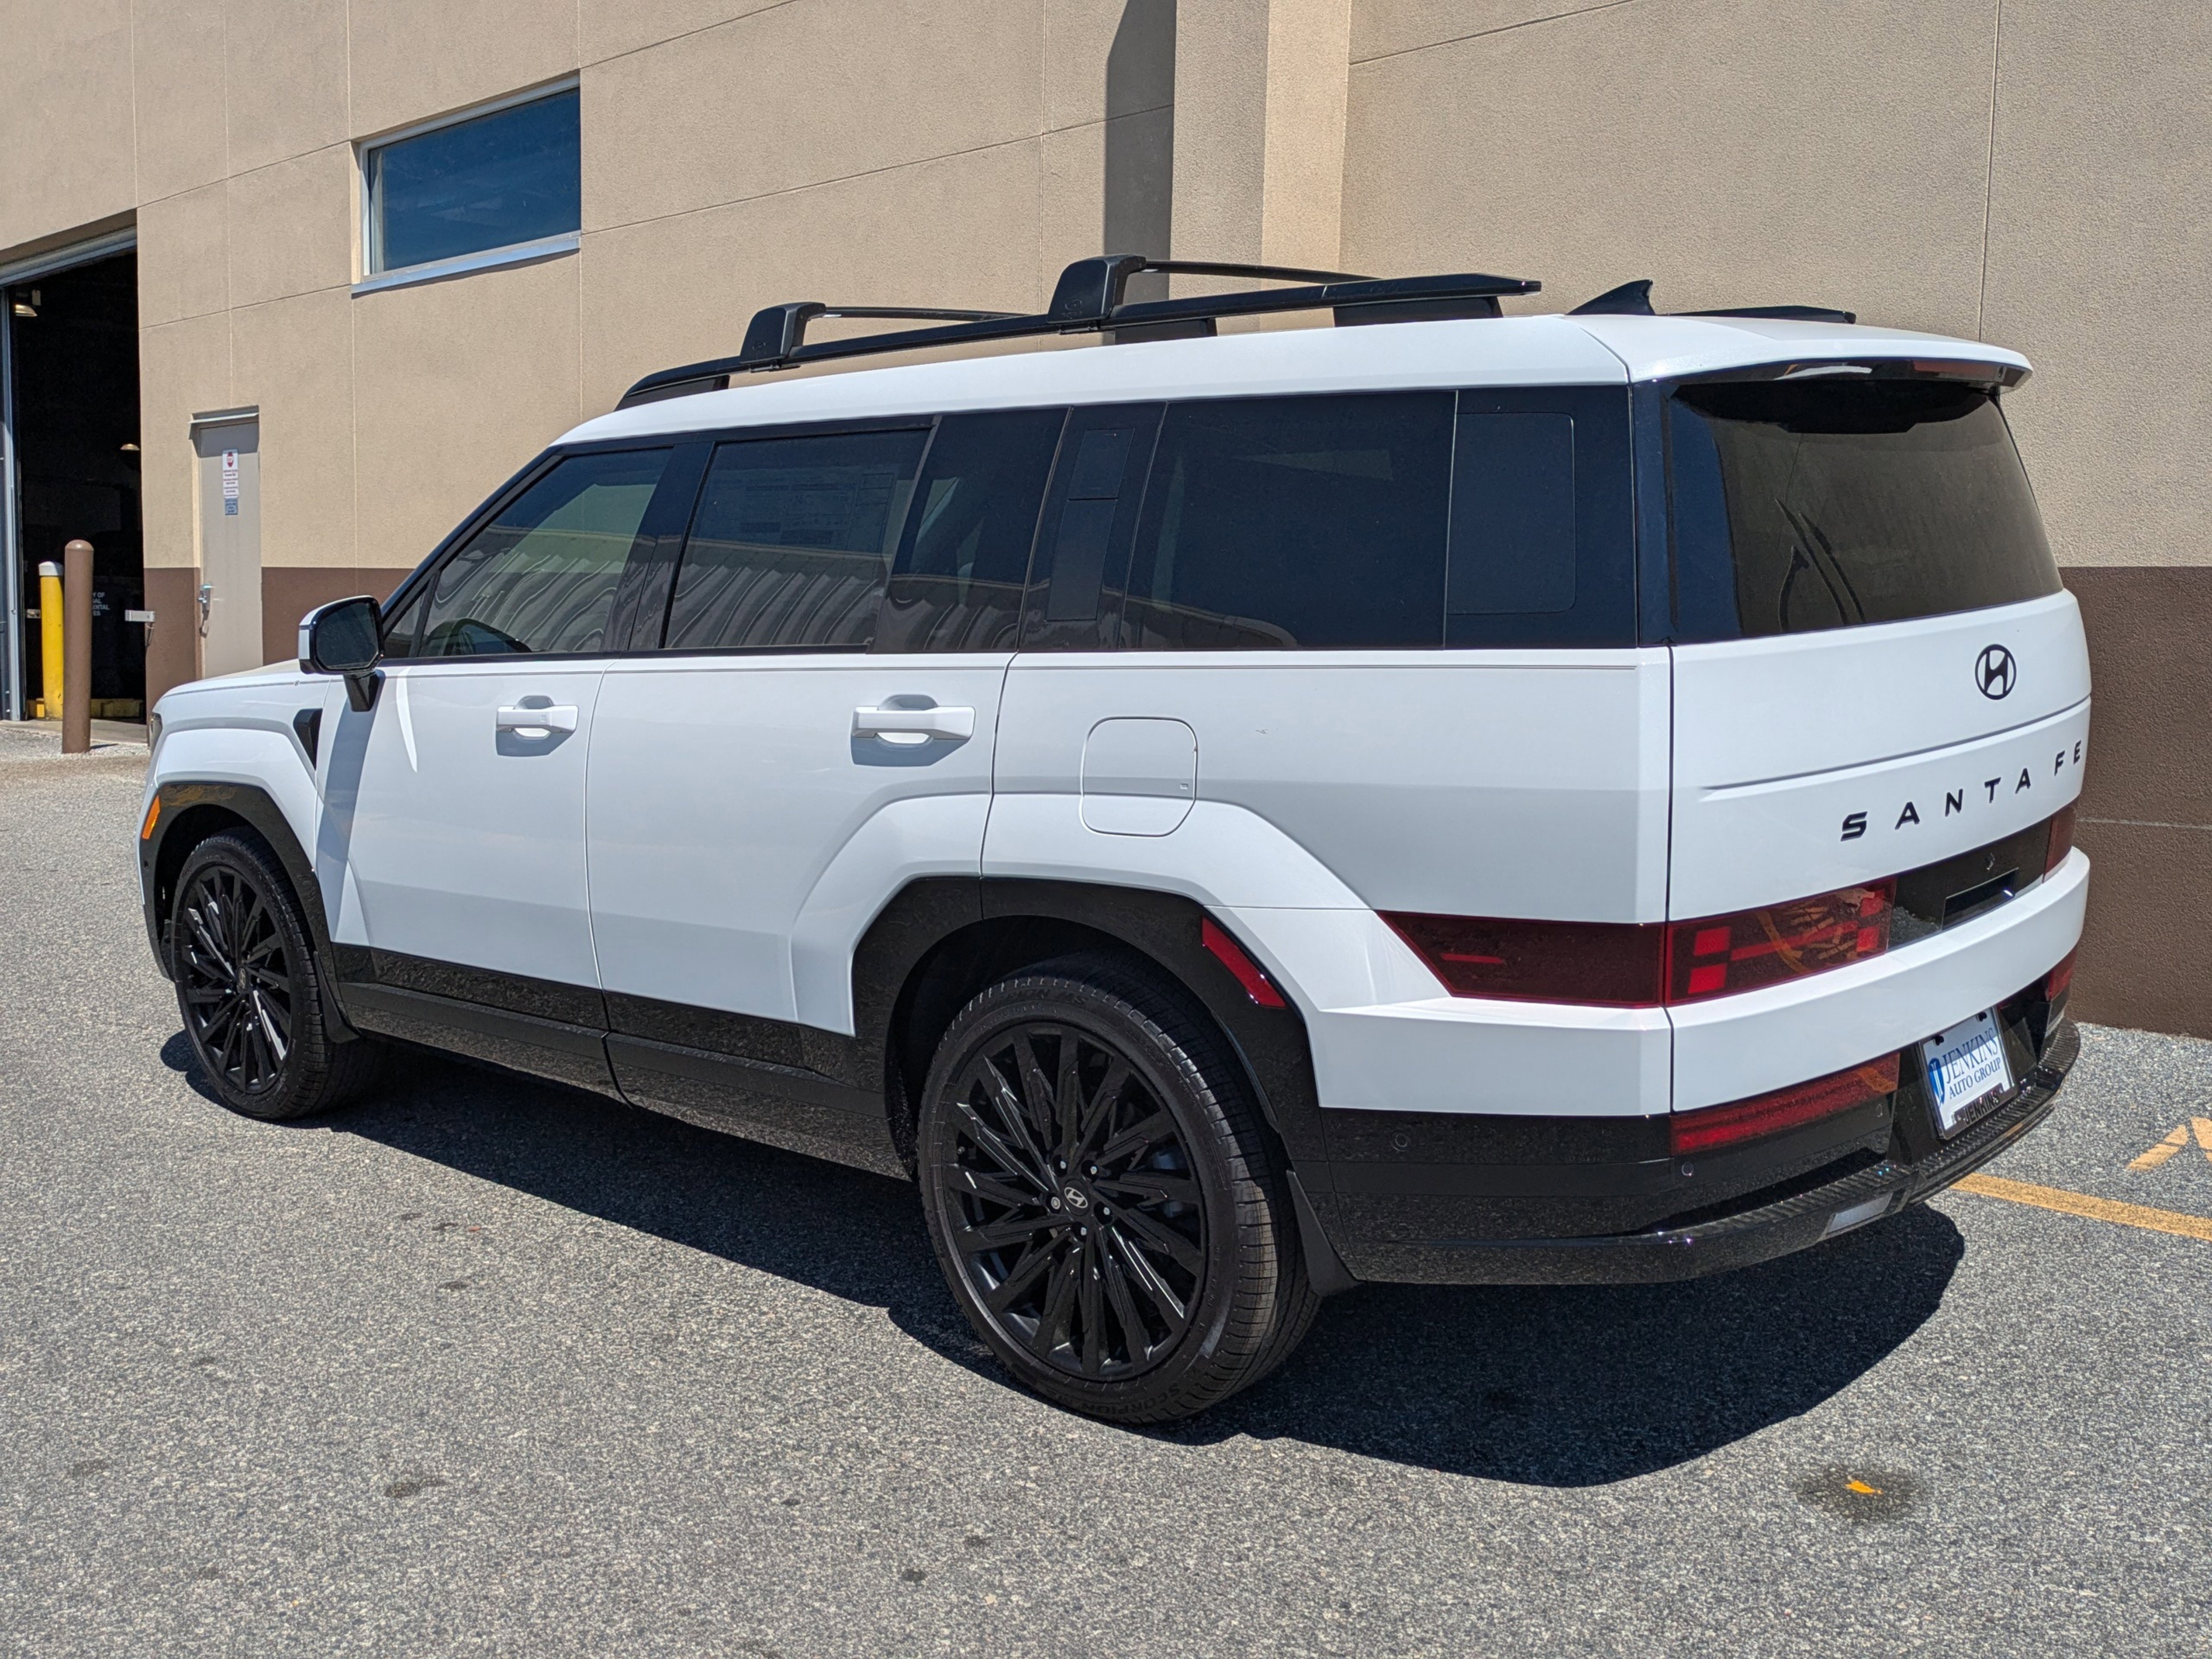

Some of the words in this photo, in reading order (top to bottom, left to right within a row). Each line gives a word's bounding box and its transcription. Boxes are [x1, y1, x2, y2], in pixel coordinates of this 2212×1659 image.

[1841, 768, 2031, 841] SANTA
[2054, 740, 2082, 776] FE
[1942, 1028, 1998, 1084] JENKINS
[1949, 1076, 1973, 1099] AUTO
[1974, 1057, 2001, 1083] GROUP
